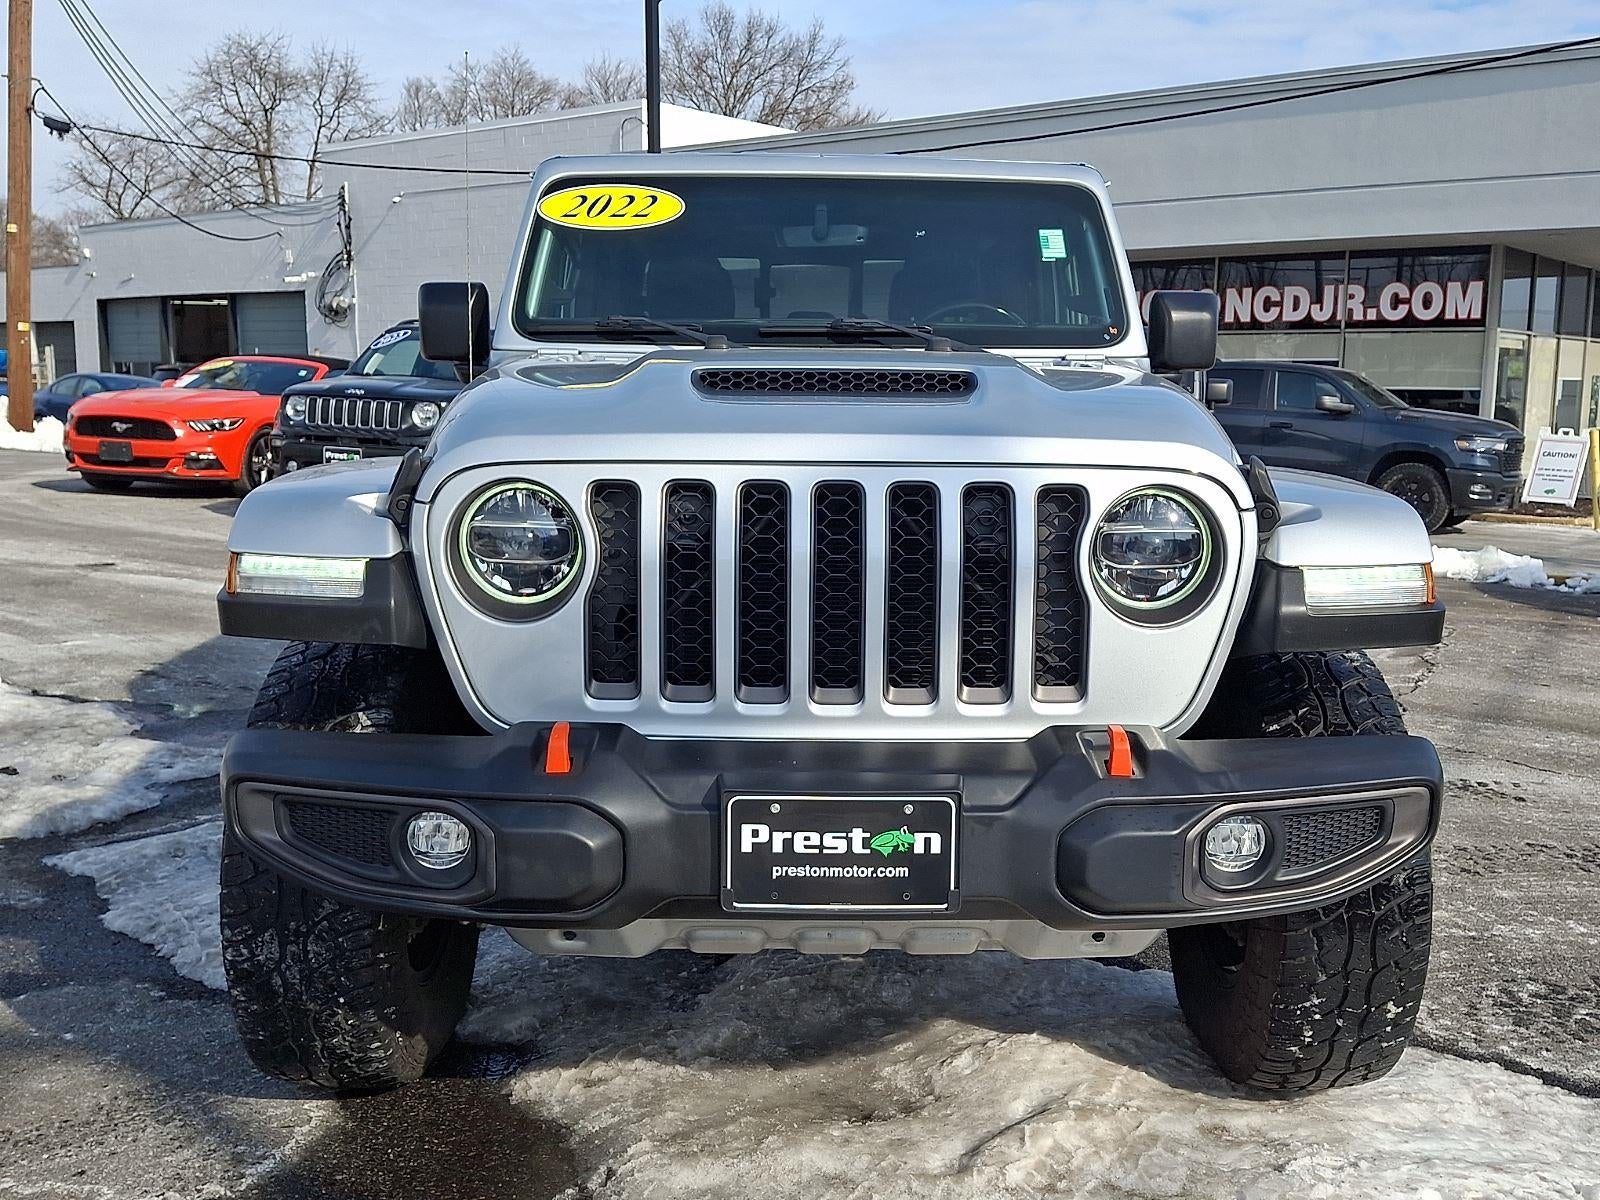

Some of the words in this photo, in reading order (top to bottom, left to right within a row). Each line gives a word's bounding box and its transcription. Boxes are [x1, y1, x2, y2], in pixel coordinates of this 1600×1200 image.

[560, 194, 658, 218] 2022
[1137, 281, 1485, 324] NCDJR.COM
[325, 451, 360, 462] Prestn
[1542, 450, 1578, 459] CAUTION!
[741, 823, 942, 857] Prestn
[772, 865, 909, 879] prestonmotor.com
